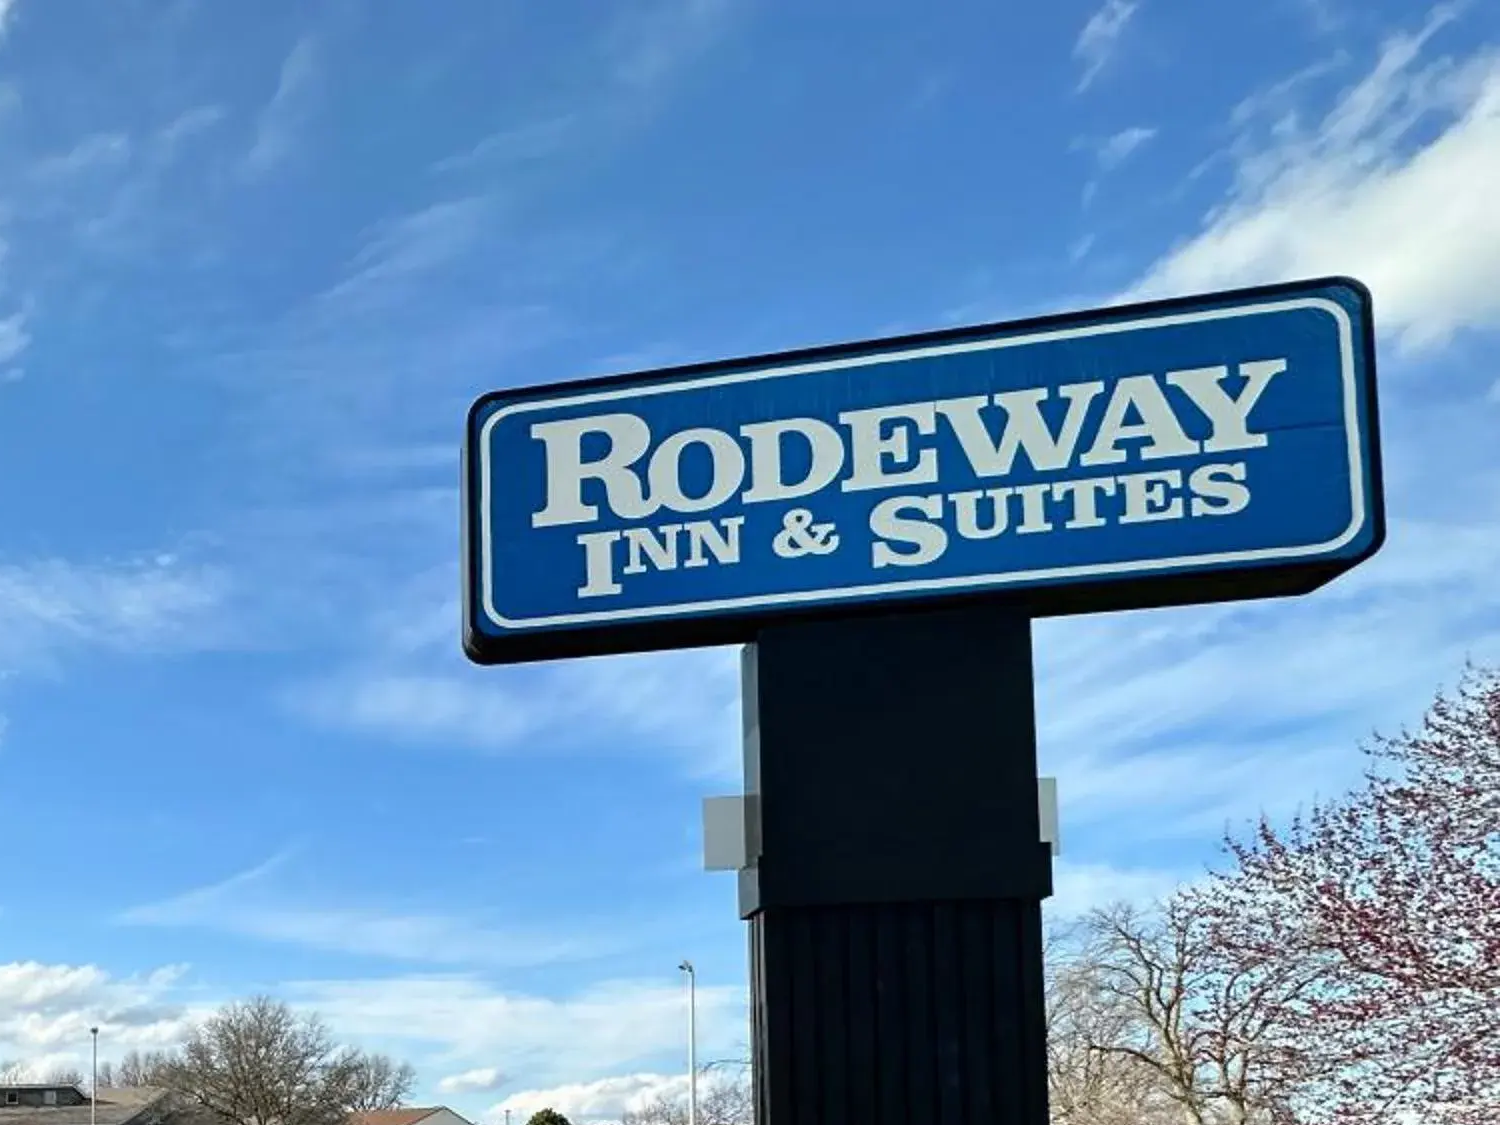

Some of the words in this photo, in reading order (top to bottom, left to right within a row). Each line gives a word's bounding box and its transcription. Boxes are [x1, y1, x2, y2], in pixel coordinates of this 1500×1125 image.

[531, 358, 1287, 528] RODEWAY
[577, 516, 745, 598] INN
[772, 508, 839, 558] &
[870, 462, 1250, 568] SUITES
